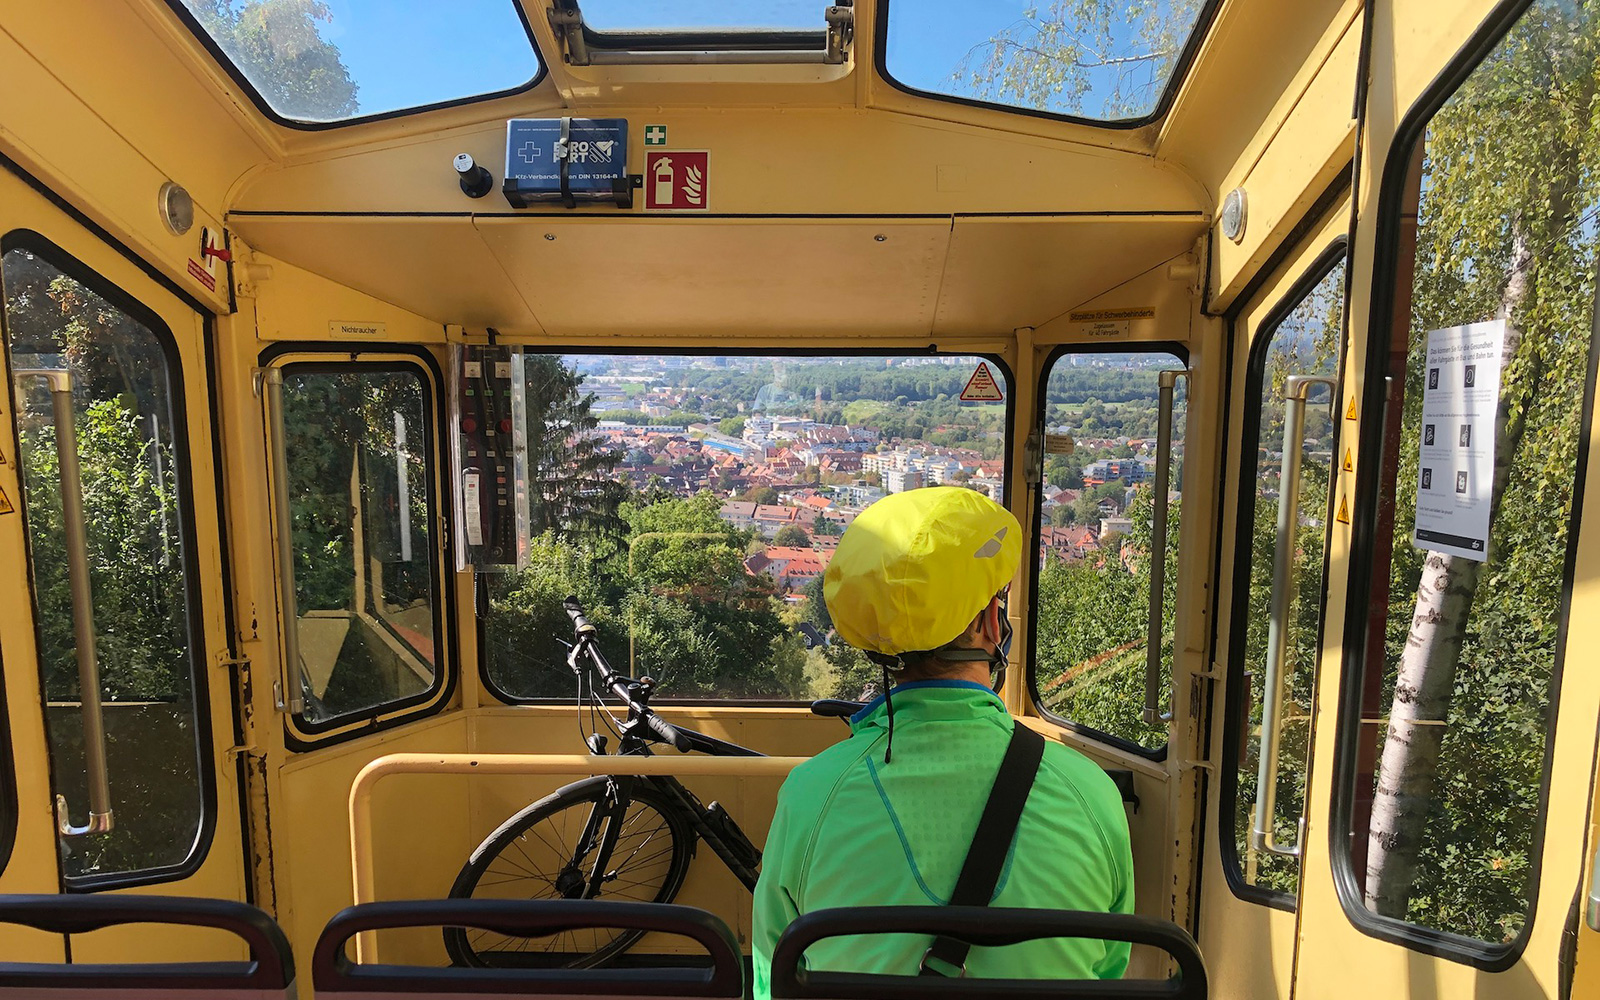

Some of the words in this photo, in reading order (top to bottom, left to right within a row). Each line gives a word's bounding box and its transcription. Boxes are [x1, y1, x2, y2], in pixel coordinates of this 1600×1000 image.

[553, 141, 589, 153] ERO
[553, 152, 589, 163] PRT
[1104, 309, 1155, 319] Schwerbehinderte
[341, 326, 377, 334] Nichtraucher
